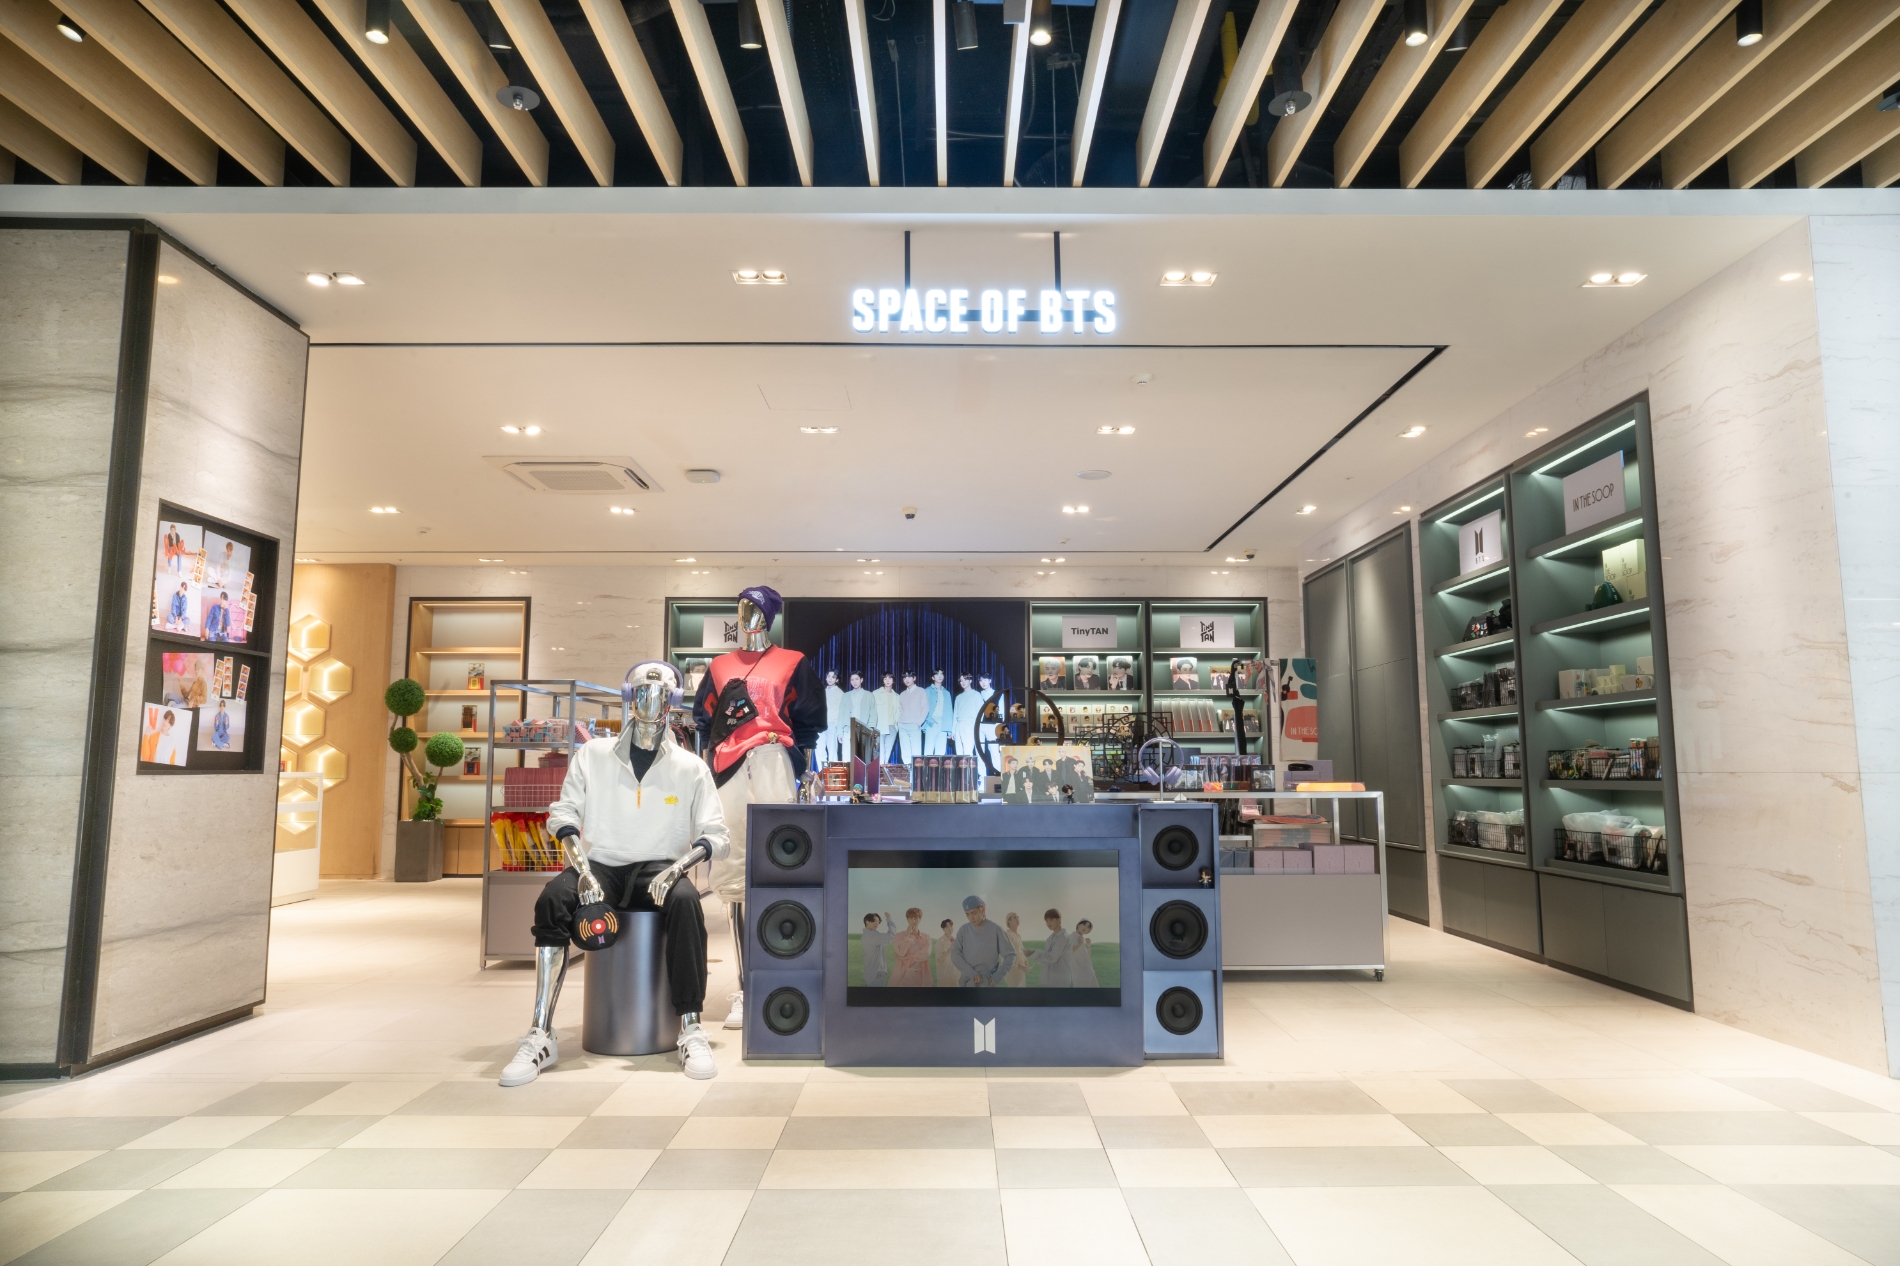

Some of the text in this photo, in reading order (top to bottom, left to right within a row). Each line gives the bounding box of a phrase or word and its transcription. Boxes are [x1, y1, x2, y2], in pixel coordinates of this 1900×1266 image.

[852, 288, 1116, 335] SPACE OF BTS
[1580, 493, 1591, 509] THE
[1592, 483, 1614, 504] SOOP
[1070, 627, 1109, 636] TinyTAN
[1290, 727, 1297, 735] IN
[1298, 727, 1309, 735] THE
